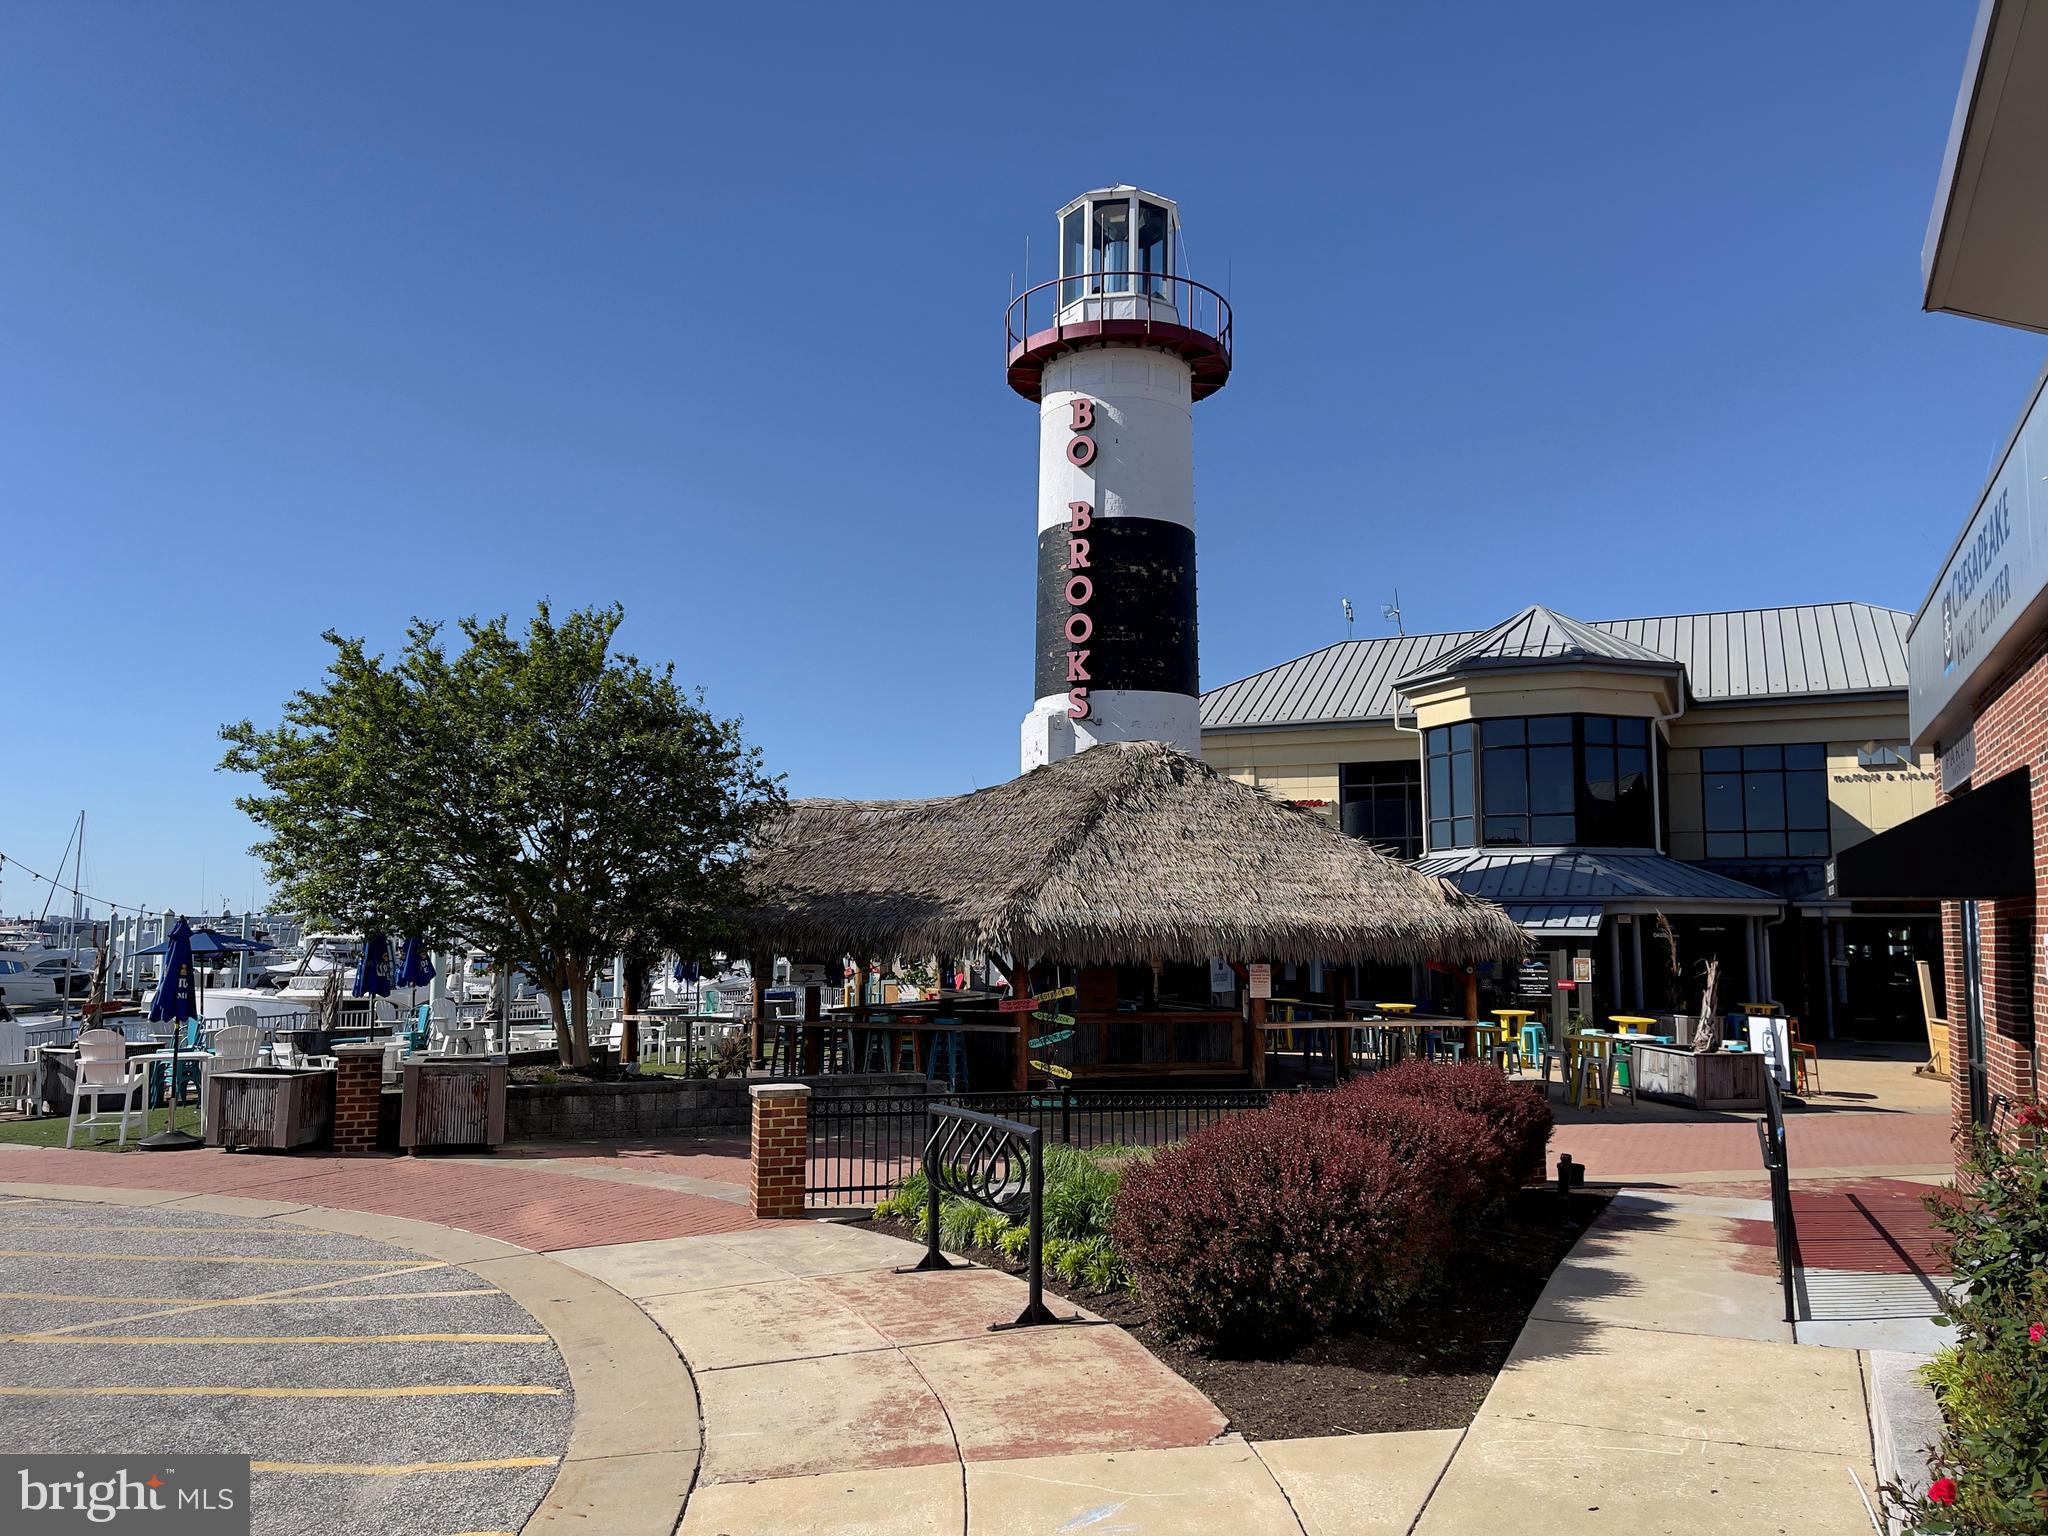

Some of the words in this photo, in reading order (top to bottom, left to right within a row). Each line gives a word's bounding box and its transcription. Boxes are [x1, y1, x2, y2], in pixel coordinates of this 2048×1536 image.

[1066, 398, 1096, 467] BO
[1064, 501, 1093, 719] BROOKS
[1951, 487, 2011, 618] CHESAPEAKE
[1956, 609, 1977, 666] YACHT
[1980, 563, 2012, 635] CENTER
